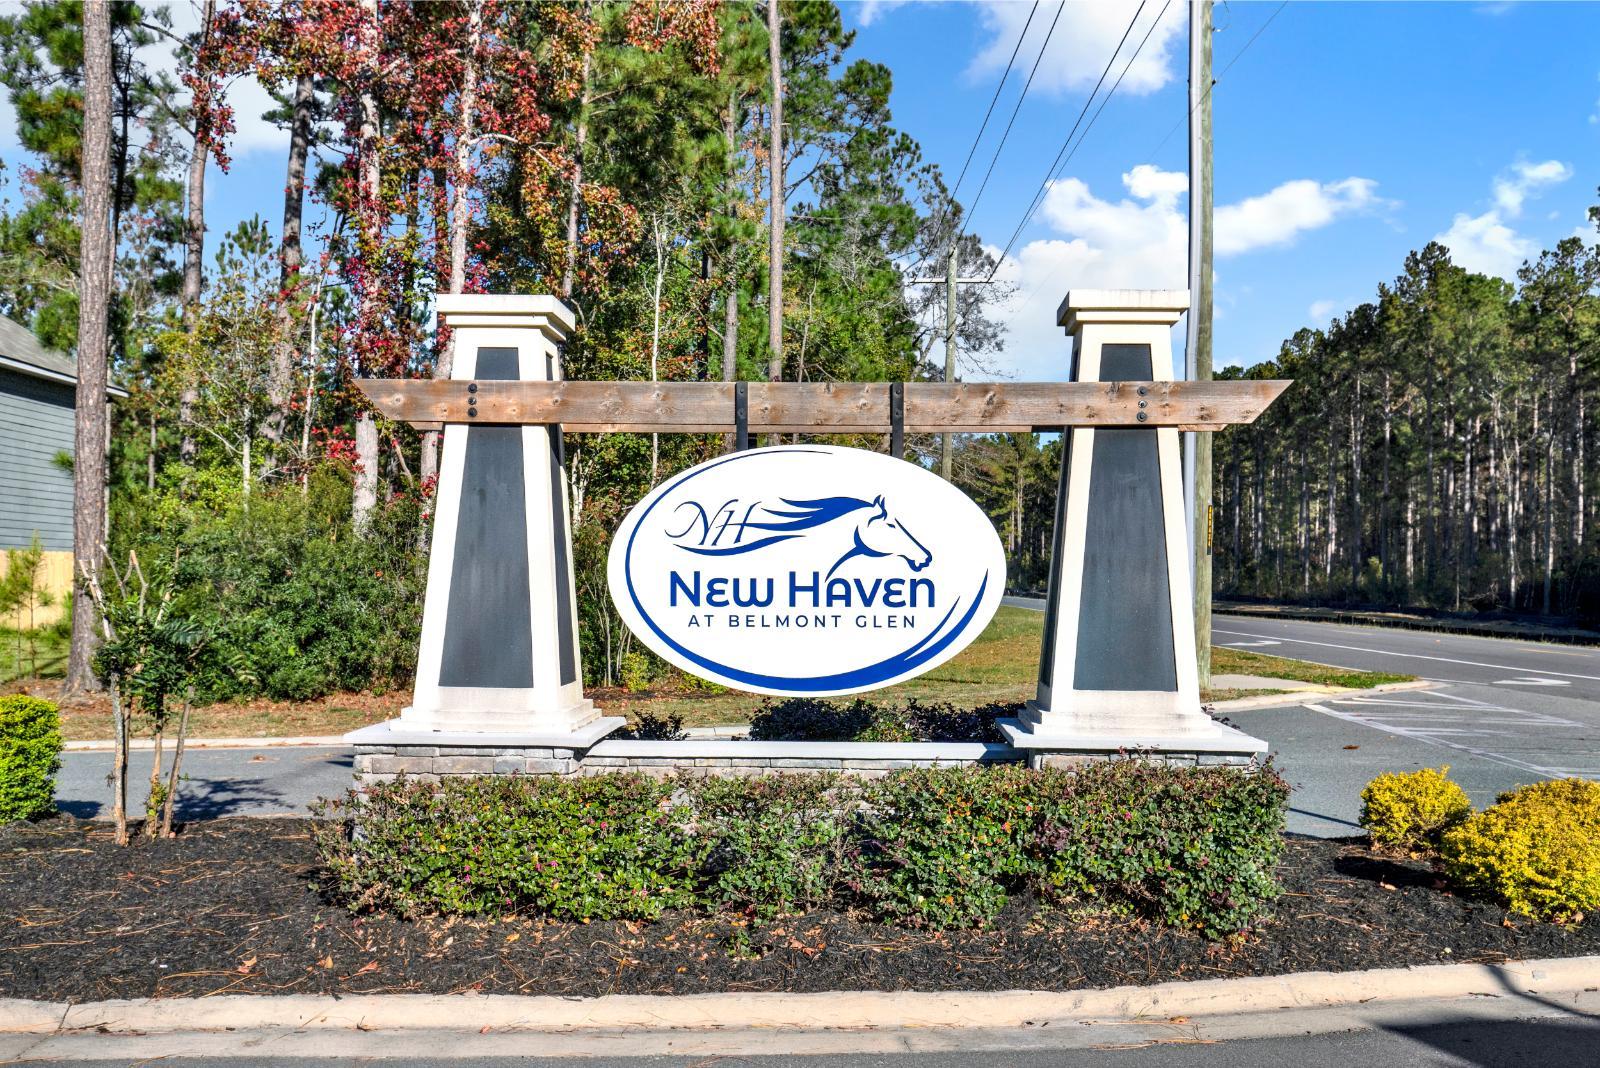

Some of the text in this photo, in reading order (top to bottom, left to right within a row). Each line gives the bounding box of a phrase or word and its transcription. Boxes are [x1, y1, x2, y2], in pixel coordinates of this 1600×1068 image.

[688, 615, 914, 628] AT BELMONT GLEN
